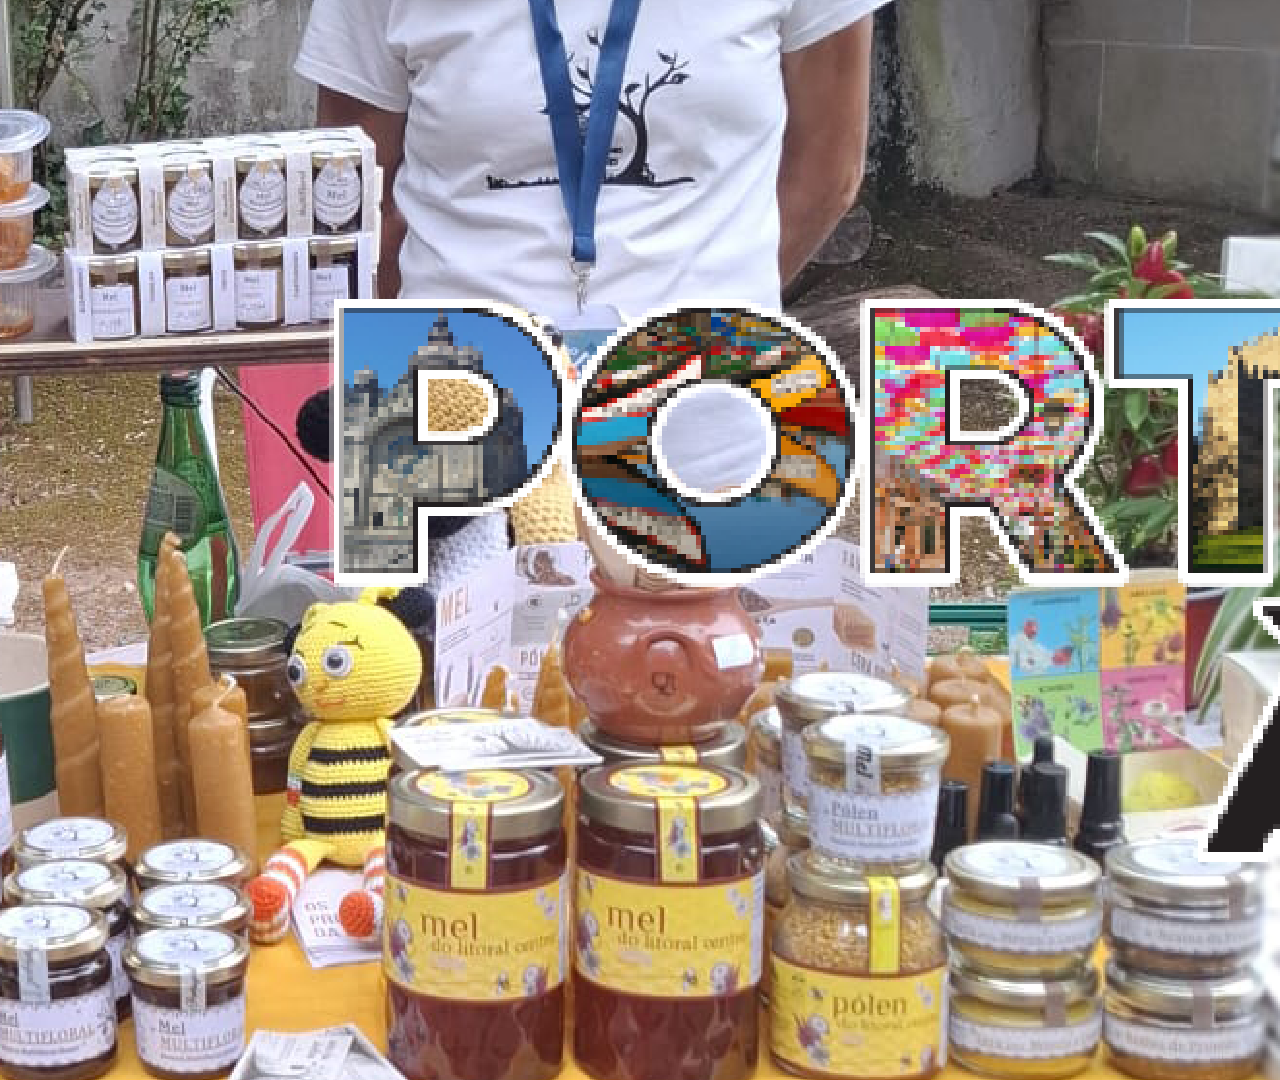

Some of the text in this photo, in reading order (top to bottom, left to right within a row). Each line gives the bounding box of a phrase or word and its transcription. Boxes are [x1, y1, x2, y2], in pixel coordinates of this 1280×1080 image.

[439, 581, 469, 627] MEL
[831, 801, 879, 821] Pólen
[420, 910, 477, 940] mel
[607, 905, 666, 934] mel
[458, 938, 509, 957] litoral
[644, 933, 698, 952] litoral
[831, 993, 908, 1020] pólen
[157, 1019, 186, 1036] Mel
